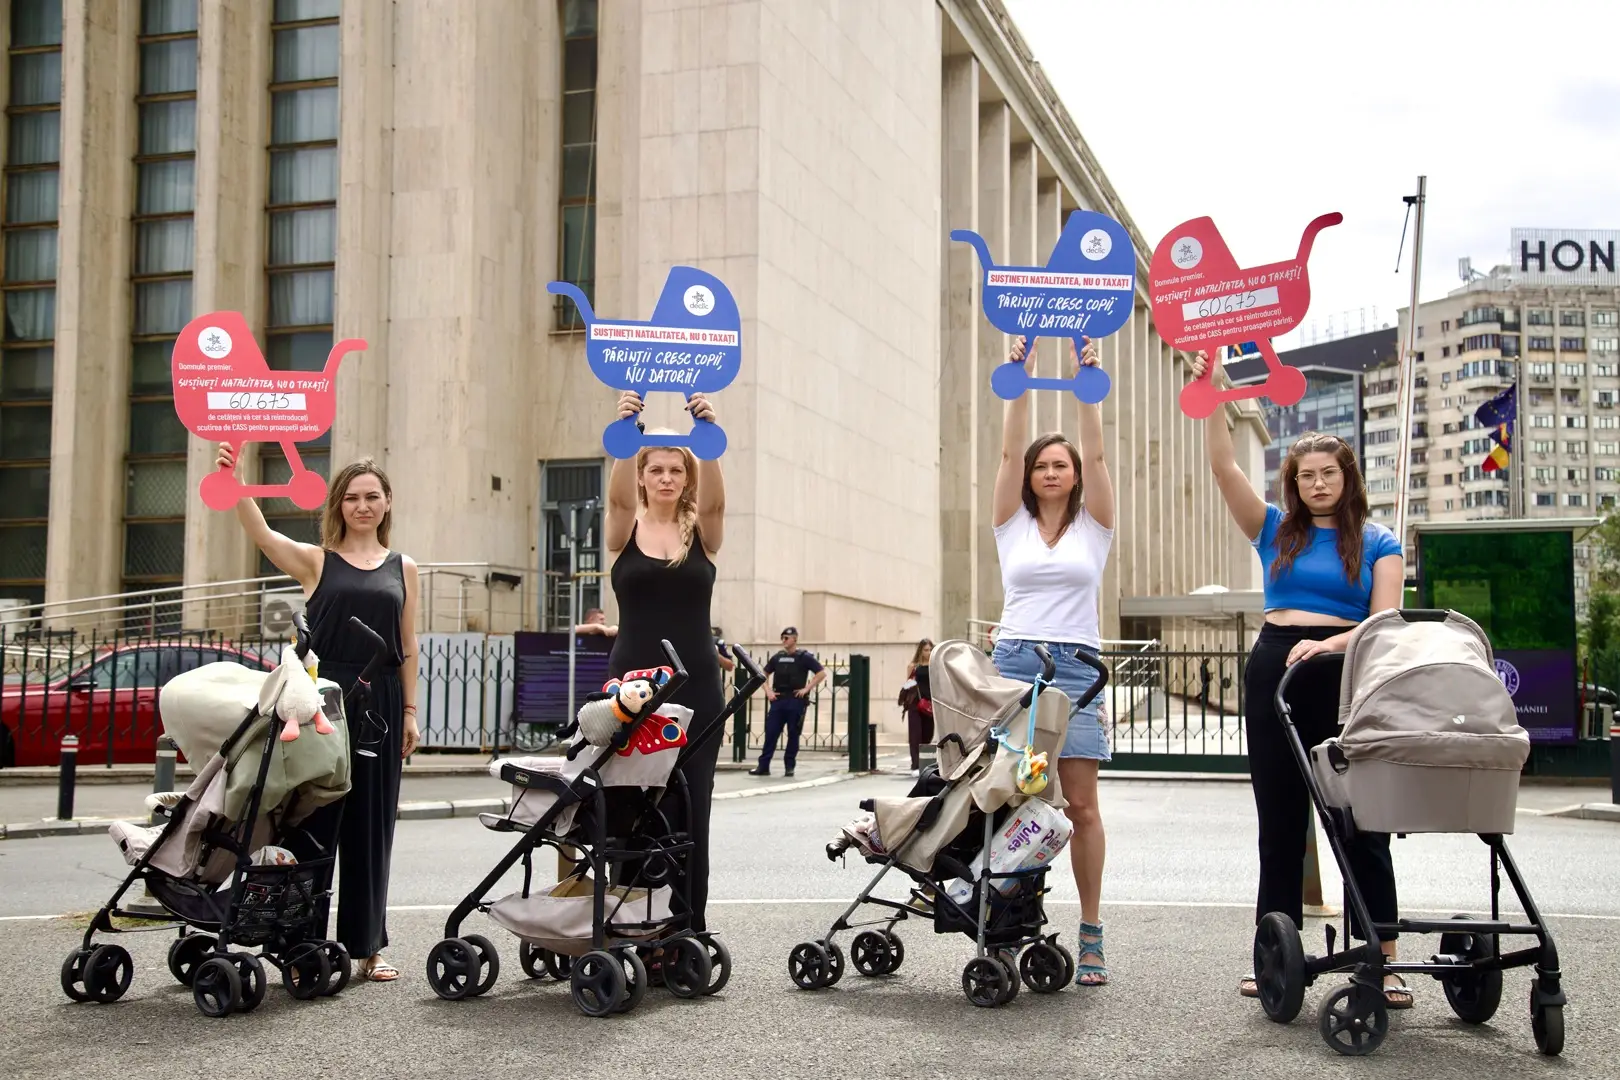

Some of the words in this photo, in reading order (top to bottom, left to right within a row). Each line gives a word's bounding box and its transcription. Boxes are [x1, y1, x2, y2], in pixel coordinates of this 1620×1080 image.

[1521, 239, 1615, 272] HON
[990, 274, 1029, 285] SUSȚINEȚI
[1030, 276, 1081, 287] NATALITATEA,
[1083, 278, 1094, 286] NU
[1095, 278, 1100, 286] O
[1102, 278, 1129, 288] TAXAȚI
[1154, 276, 1180, 287] Domnule
[1248, 275, 1259, 286] NU
[1260, 275, 1266, 284] O
[1047, 296, 1083, 310] CRESC
[1086, 296, 1118, 315] COPII,
[1199, 289, 1258, 318] 60675
[1017, 311, 1038, 329] NU
[1039, 313, 1091, 332] DATORII!
[1184, 324, 1192, 332] de
[1225, 317, 1235, 325] cer
[593, 328, 634, 339] SUSȚINEȚI
[635, 330, 688, 341] NATALITATEA,
[690, 332, 700, 341] NU
[702, 333, 707, 341] O
[709, 333, 735, 344] TAXAȚI
[1174, 334, 1198, 344] scutirea
[1199, 332, 1207, 340] de
[1207, 329, 1222, 338] CASS
[1222, 326, 1242, 337] pentru
[178, 362, 206, 370] Domnule
[655, 351, 692, 365] CRESC
[694, 351, 726, 370] COPII,
[277, 379, 288, 389] NU
[289, 380, 295, 389] O
[625, 366, 646, 384] NU
[648, 368, 701, 387] DATORII!
[197, 423, 222, 431] scutirea
[223, 423, 231, 431] de
[248, 424, 269, 433] pentru
